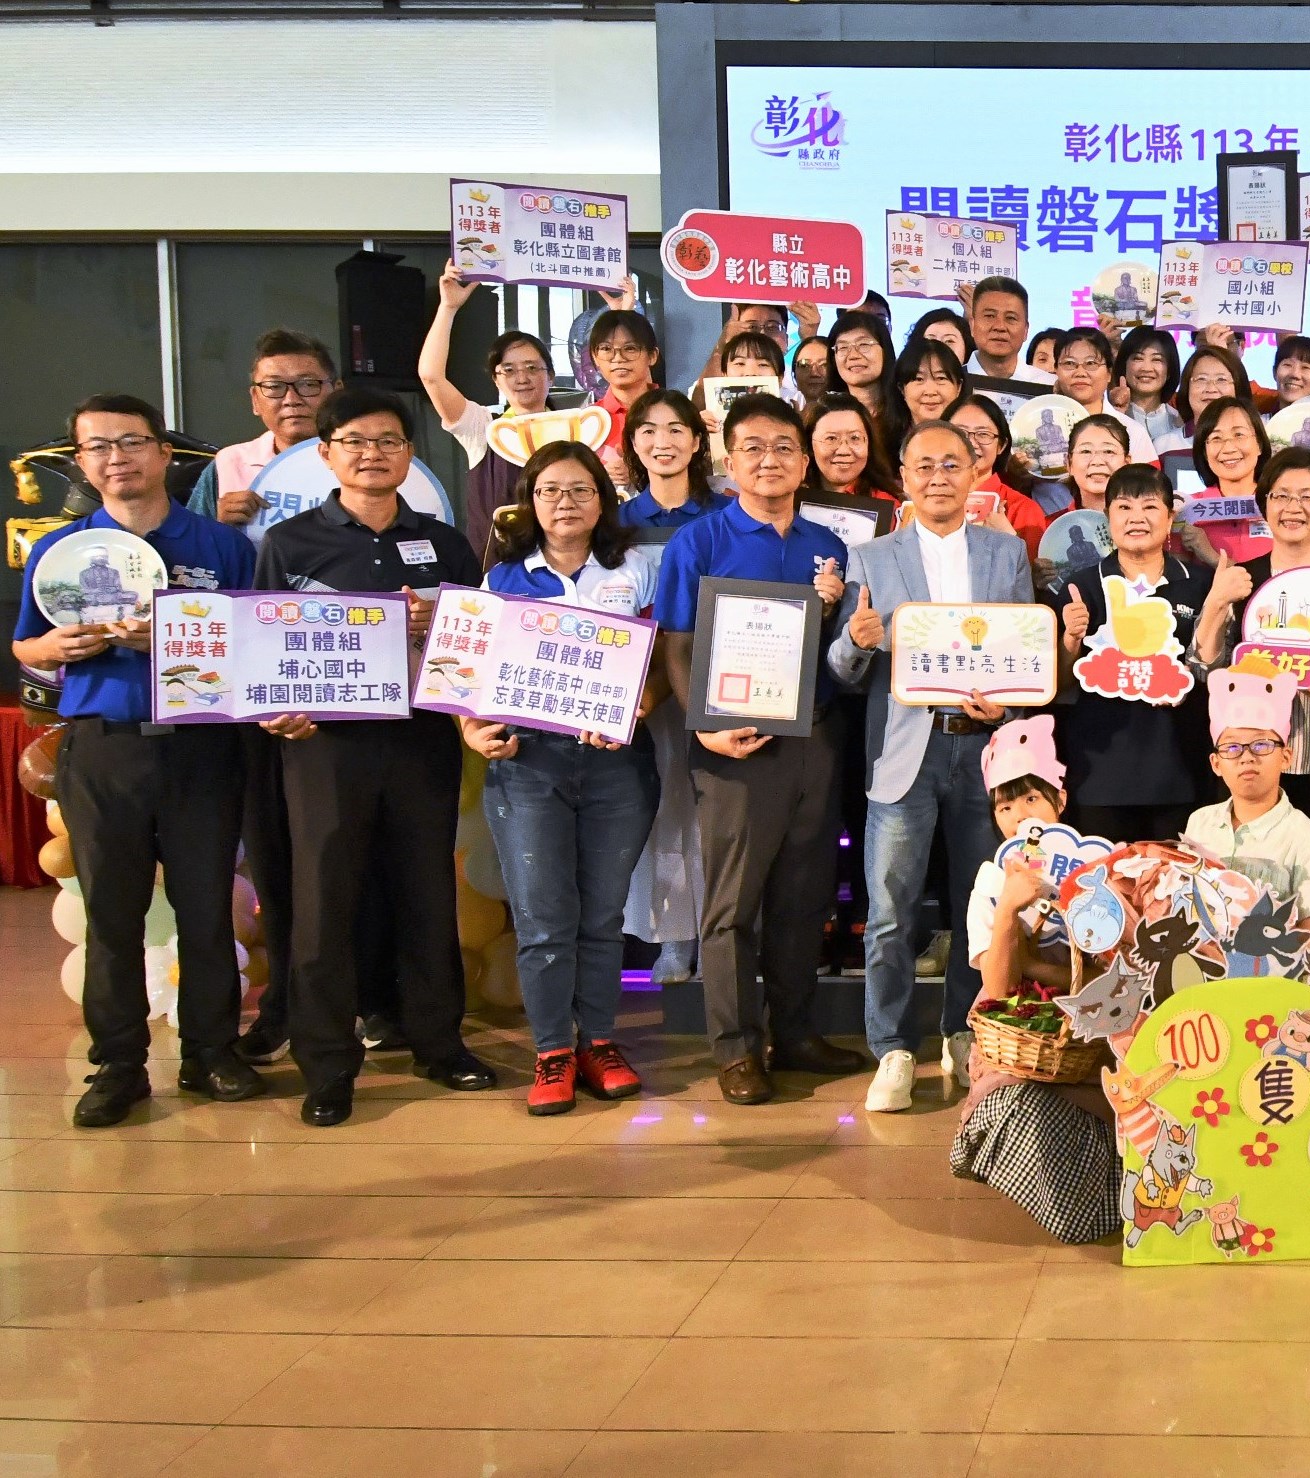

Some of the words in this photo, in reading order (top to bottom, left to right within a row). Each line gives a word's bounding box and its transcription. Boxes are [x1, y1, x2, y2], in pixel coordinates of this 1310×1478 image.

[458, 205, 501, 219] 113年
[459, 219, 501, 234] 得獎者
[540, 221, 594, 241] 團體組
[772, 232, 805, 255] 縣立
[892, 231, 924, 244] 113年
[513, 239, 622, 263] 彰化縣立圖書館
[892, 244, 924, 257] 得獎者
[952, 242, 992, 259] 個人組
[724, 258, 851, 291] 彰化藝術高中
[1164, 262, 1200, 273] 113年
[1163, 274, 1199, 287] 得獎者
[1227, 280, 1275, 296] 國小組
[1217, 299, 1282, 317] 大村國小
[1192, 499, 1256, 518] 今天閱讀
[256, 601, 386, 626] 閱讀磐石推手
[164, 621, 227, 638] 113年
[441, 615, 493, 637] 113年
[164, 640, 228, 657] 得獎者
[284, 631, 362, 652] 團體組
[436, 632, 489, 655] 得獎者
[536, 641, 604, 670] 團體組
[911, 653, 1042, 674] 讀書點亮生活
[278, 658, 367, 680] 埔心國中
[1117, 659, 1154, 691] 讚
[246, 683, 402, 704] 埔園閱讀志工隊
[492, 685, 625, 725] 忘憂草勵學天使團
[1163, 1013, 1219, 1070] 100
[1252, 1060, 1299, 1126] 隻
